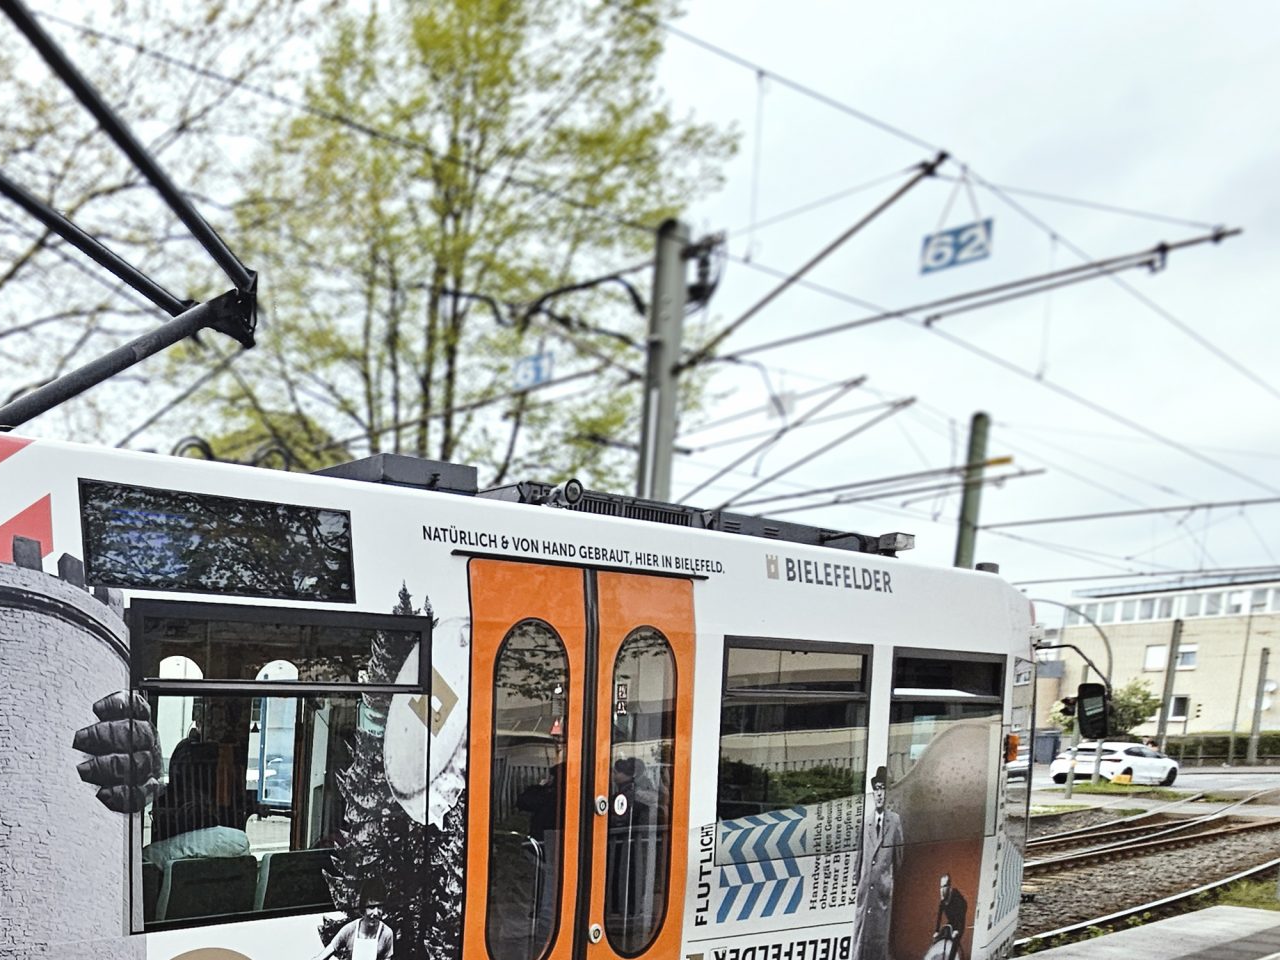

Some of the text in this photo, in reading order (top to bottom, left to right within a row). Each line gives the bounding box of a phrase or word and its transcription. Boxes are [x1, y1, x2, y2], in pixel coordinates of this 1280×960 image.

[923, 226, 990, 268] 62
[422, 525, 726, 574] NATÜRLICH & VON HAND GEBRAUT, HIER IN BIELEFELD.
[785, 557, 893, 593] BIELEFELDER
[843, 810, 854, 848] Hopfen
[695, 825, 714, 927] FLUTLICHT
[828, 867, 840, 907] feiner
[838, 852, 851, 908] lertauer
